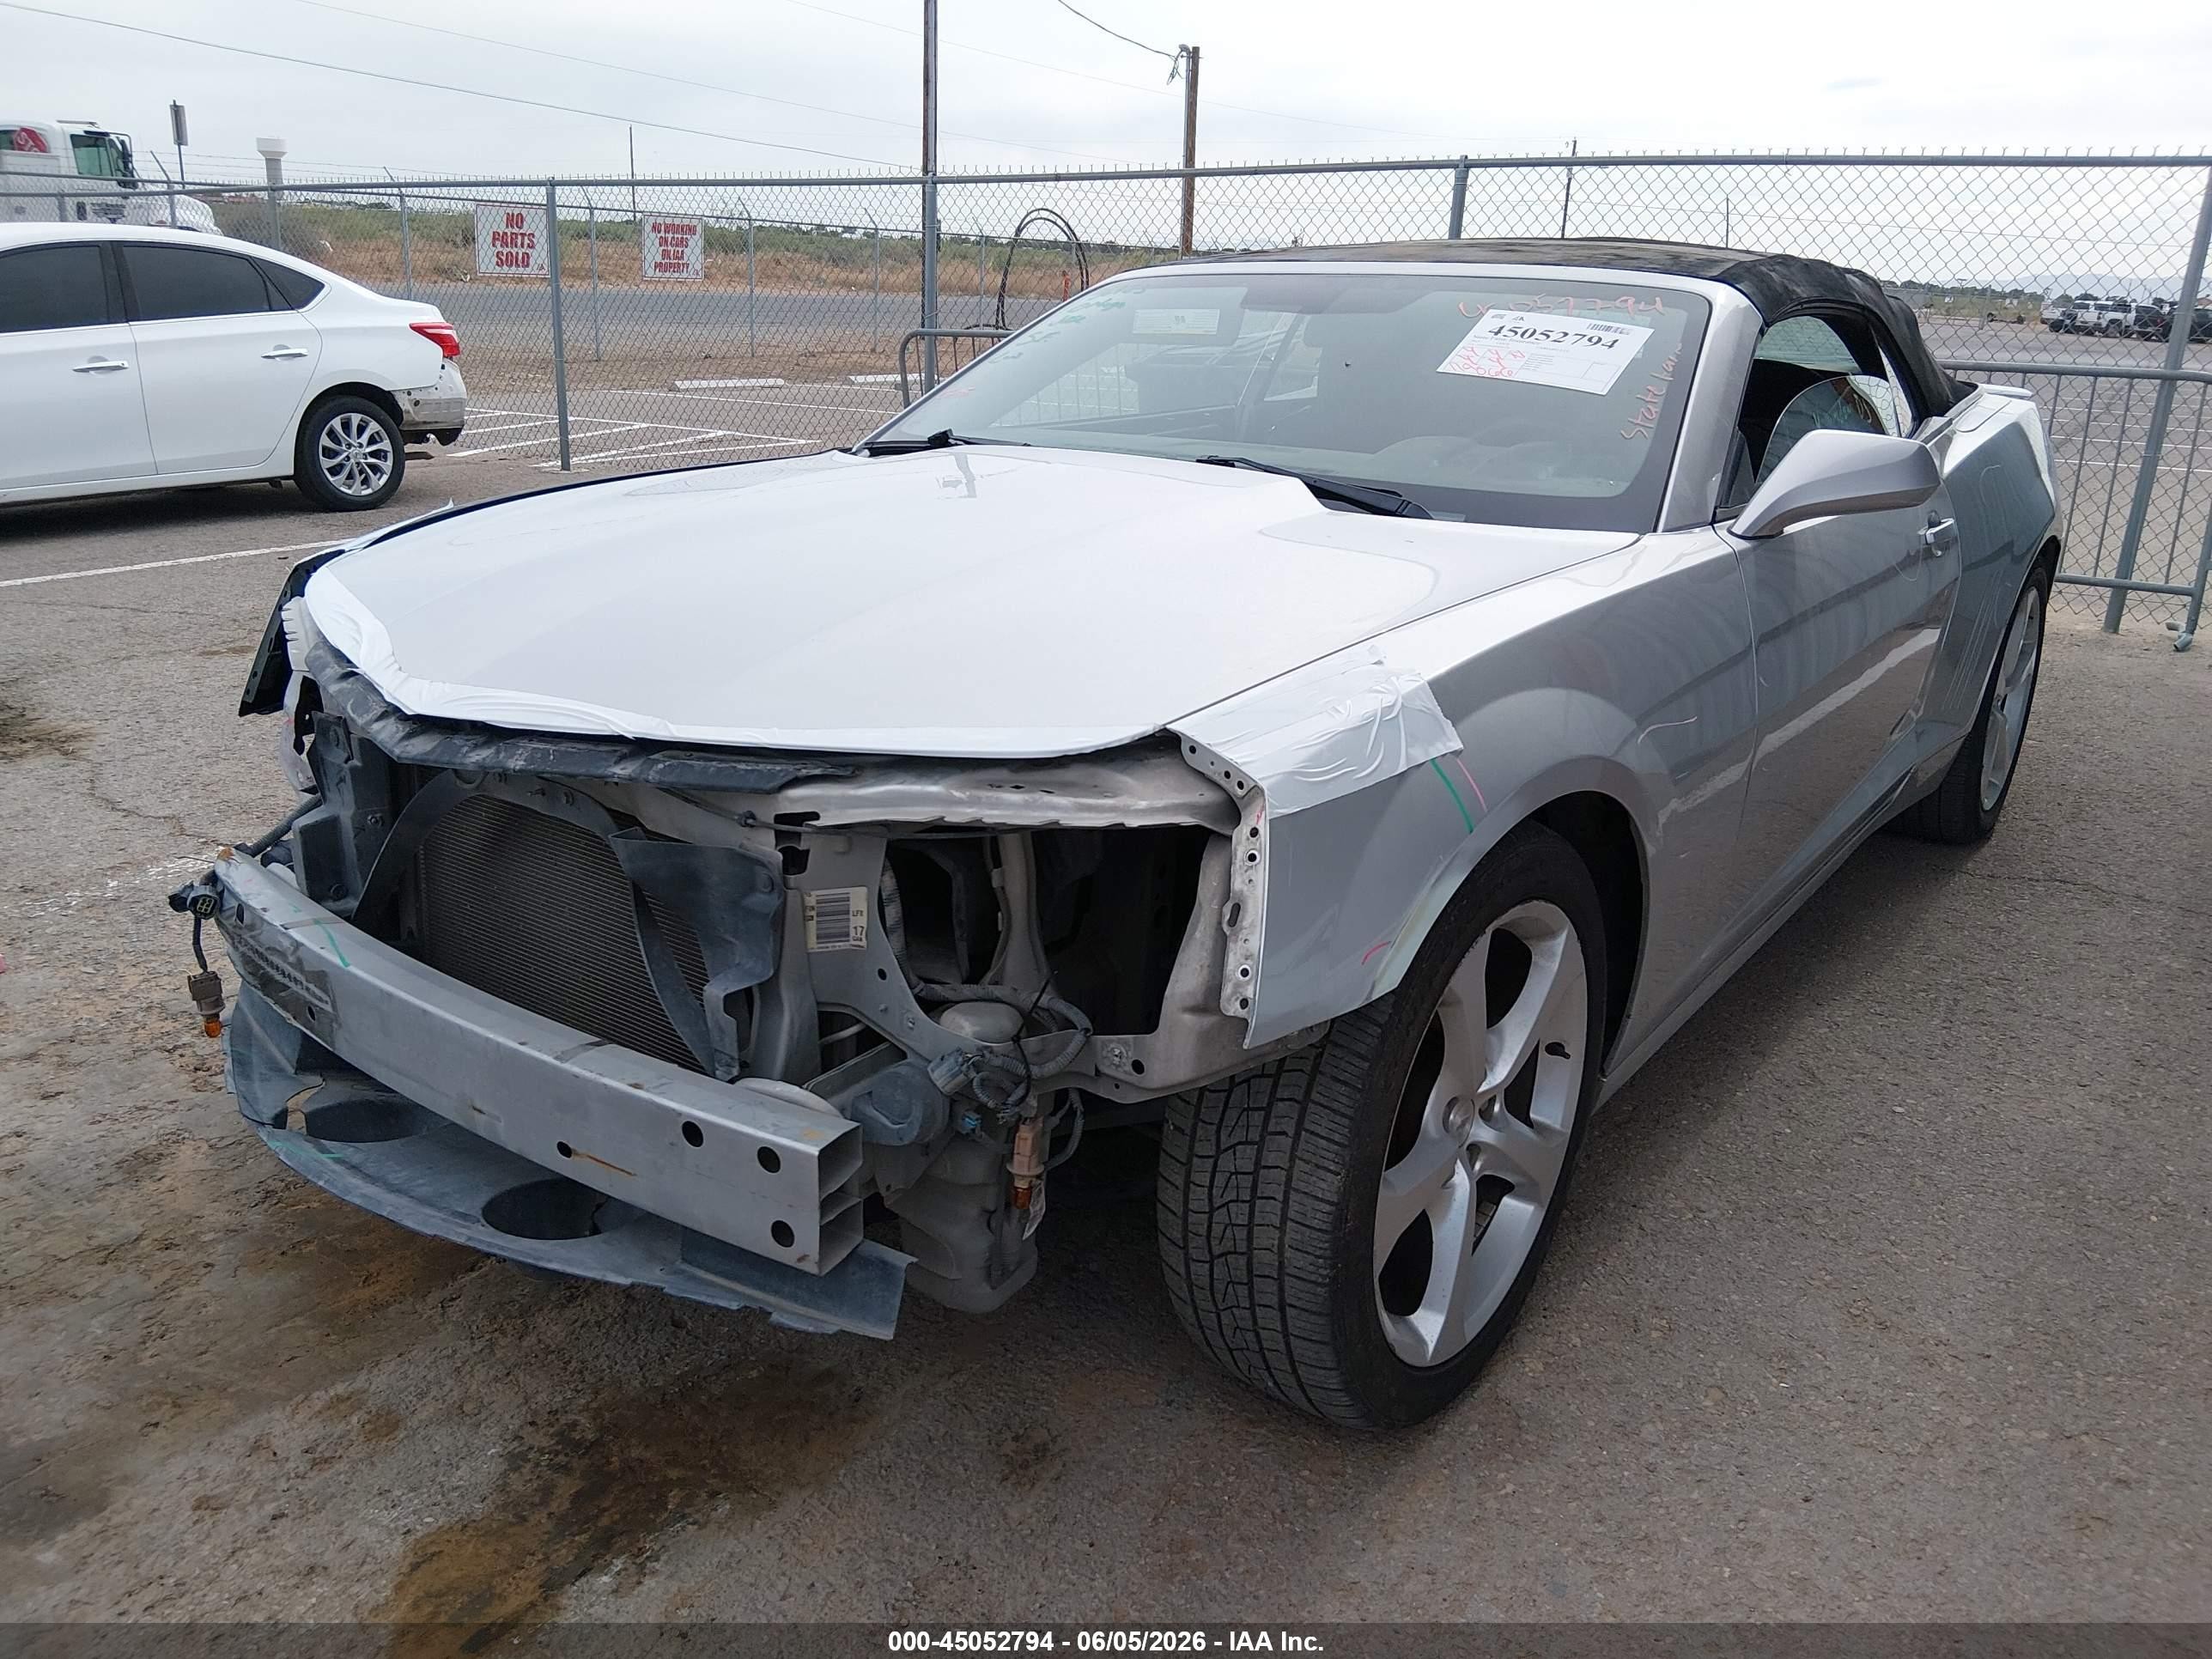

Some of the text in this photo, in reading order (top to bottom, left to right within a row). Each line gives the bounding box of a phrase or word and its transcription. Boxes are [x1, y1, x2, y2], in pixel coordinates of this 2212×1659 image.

[506, 212, 524, 229] NO
[652, 222, 697, 235] NO WORKING
[492, 231, 536, 249] PARTS
[659, 236, 689, 249] ON CARS
[495, 251, 531, 269] SOLD
[661, 249, 672, 261] ON
[653, 261, 690, 274] PROPERTY
[1487, 325, 1620, 350] 45052794
[853, 926, 865, 936] 17
